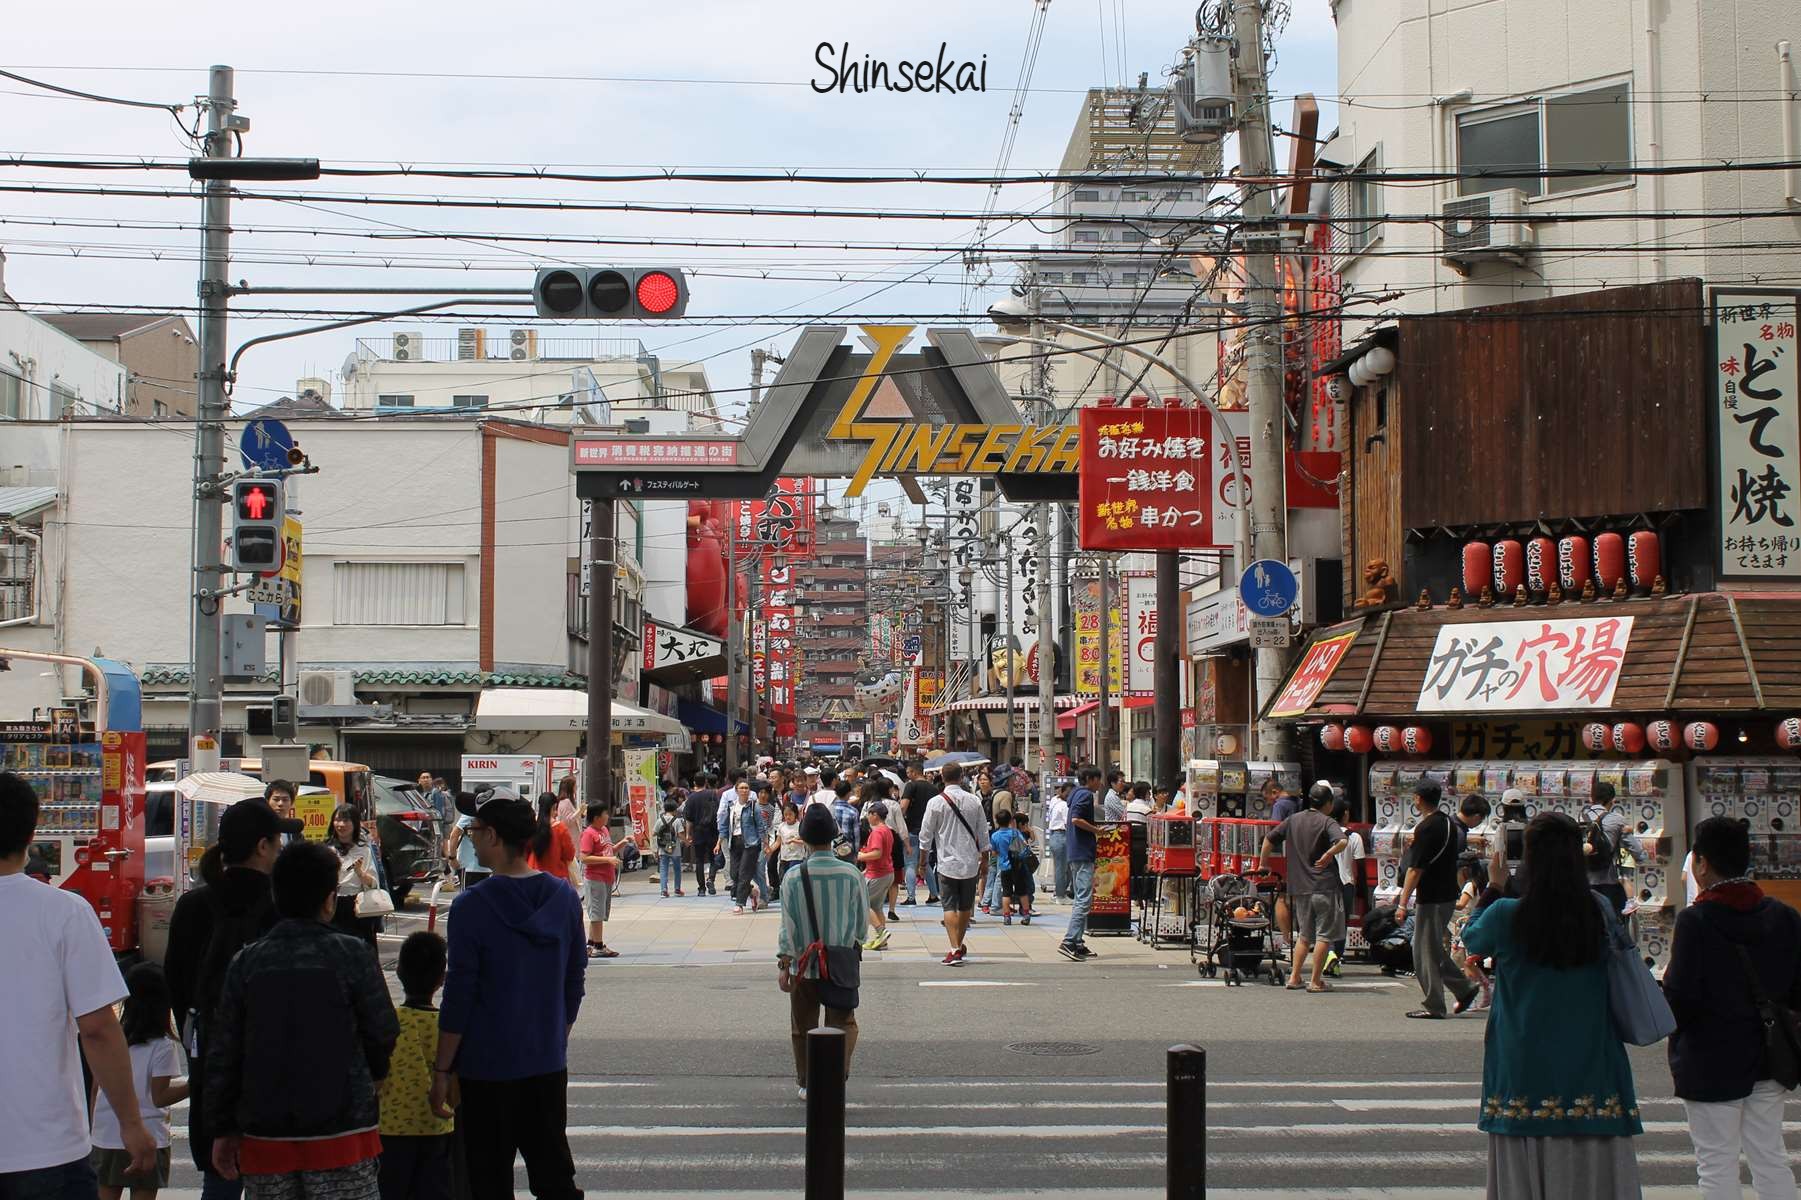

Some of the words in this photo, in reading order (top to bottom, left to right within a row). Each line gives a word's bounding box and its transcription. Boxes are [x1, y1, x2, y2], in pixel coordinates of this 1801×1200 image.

[1719, 302, 1774, 324] 新世界
[1759, 321, 1794, 341] 名物
[1728, 342, 1795, 527] どて焼
[1098, 437, 1205, 460] お好み焼き
[647, 480, 700, 490] フェスティバルゲート
[1106, 469, 1196, 493] 一銭洋食
[1140, 505, 1204, 528] 串かつ
[1724, 535, 1800, 552] お持ち帰り
[1736, 554, 1789, 569] できます
[248, 591, 283, 603] ここから
[659, 636, 709, 661] 大丸
[1424, 618, 1624, 704] ガチャの穴場
[467, 760, 498, 769] KIRIN
[303, 814, 325, 826] 1,400
